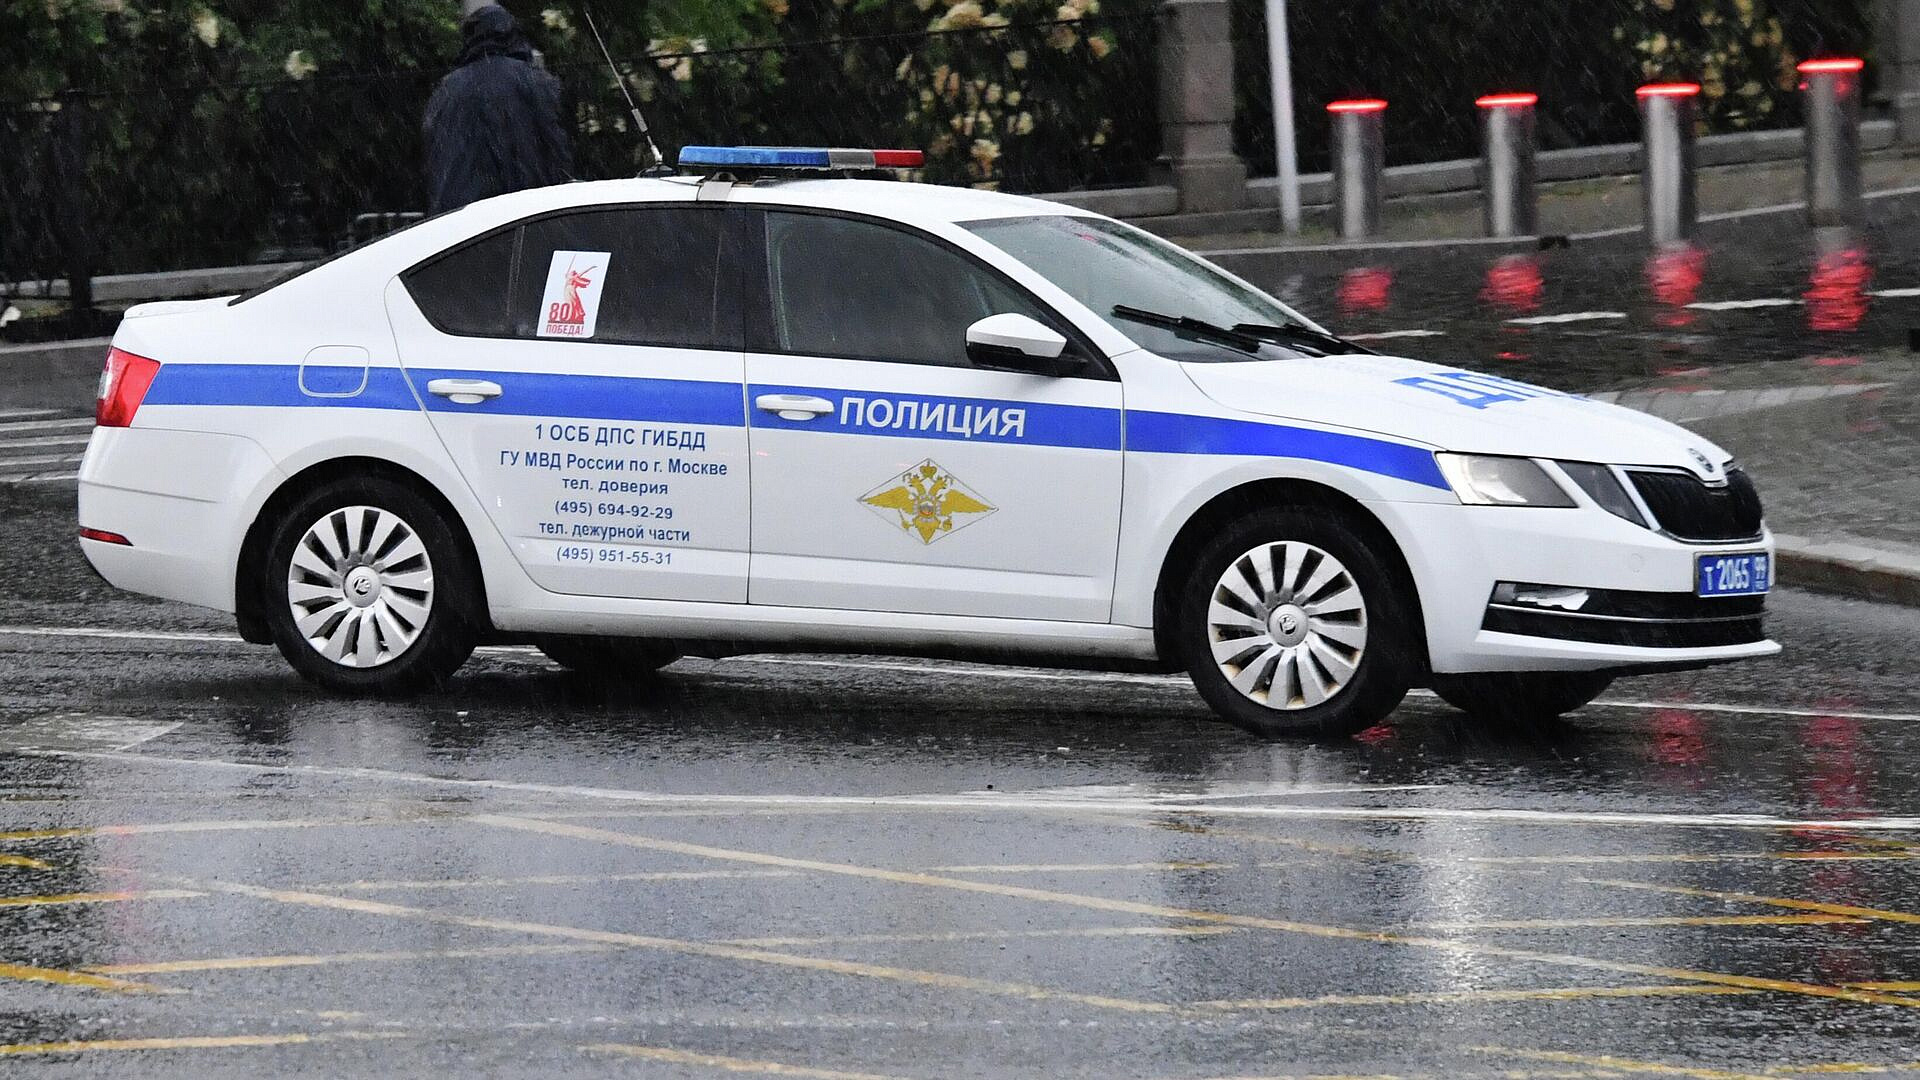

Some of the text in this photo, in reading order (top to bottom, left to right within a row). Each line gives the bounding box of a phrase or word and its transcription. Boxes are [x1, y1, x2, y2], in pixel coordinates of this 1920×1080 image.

[549, 303, 571, 321] 80
[546, 325, 584, 335] ПОБЕДА!
[1391, 372, 1592, 410] ДП
[839, 396, 1026, 438] ПОЛИЦИЯ
[535, 424, 706, 451] 1 ОСБ ДПС ГИБДД
[500, 450, 728, 476] ГУ МВД России по г. Москве
[562, 477, 669, 496] тел. доверия
[554, 500, 673, 520] (495) 694-92-29
[539, 520, 691, 542] тел. дежурной части
[556, 546, 673, 565] (495) 951-55-31
[1716, 558, 1750, 591] 2065
[1755, 556, 1767, 580] 99
